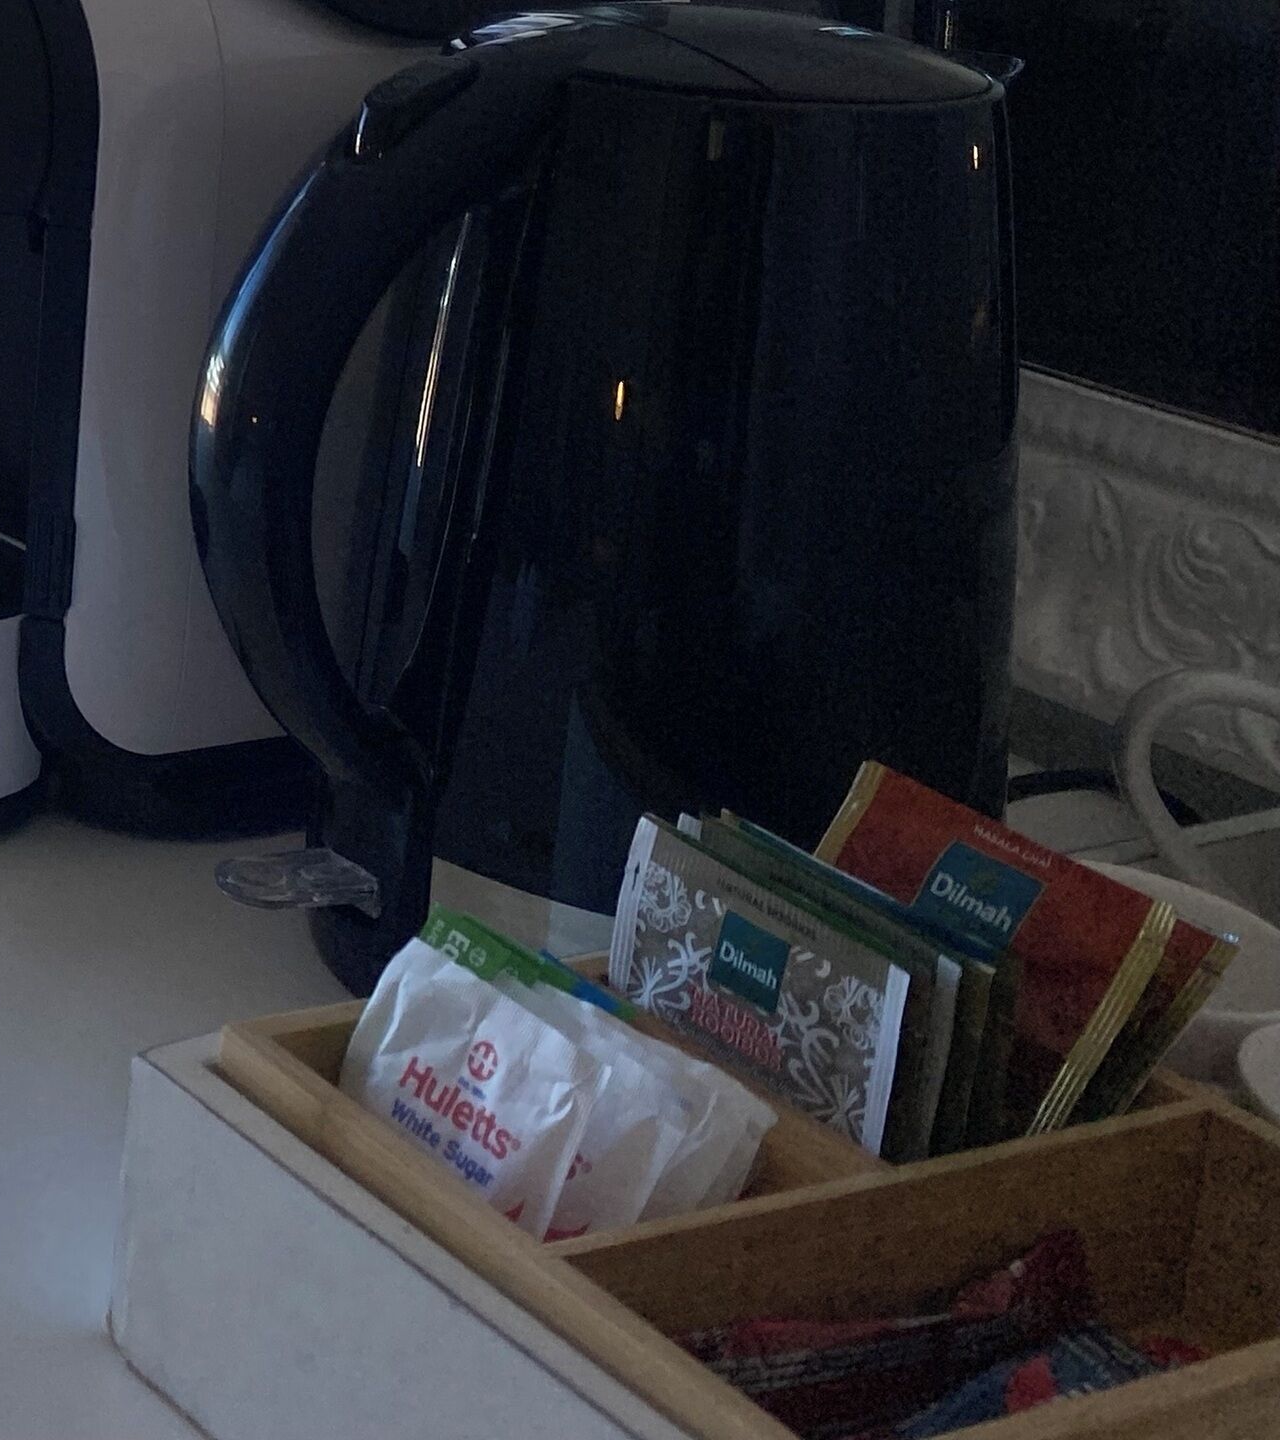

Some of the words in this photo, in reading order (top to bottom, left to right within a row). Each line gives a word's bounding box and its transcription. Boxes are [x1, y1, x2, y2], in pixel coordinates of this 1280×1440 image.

[930, 872, 1012, 932] Dilmah
[719, 940, 778, 991] Dilmah
[392, 1098, 440, 1148] White
[443, 1139, 494, 1188] Sugar
[399, 1056, 511, 1160] Huletts
